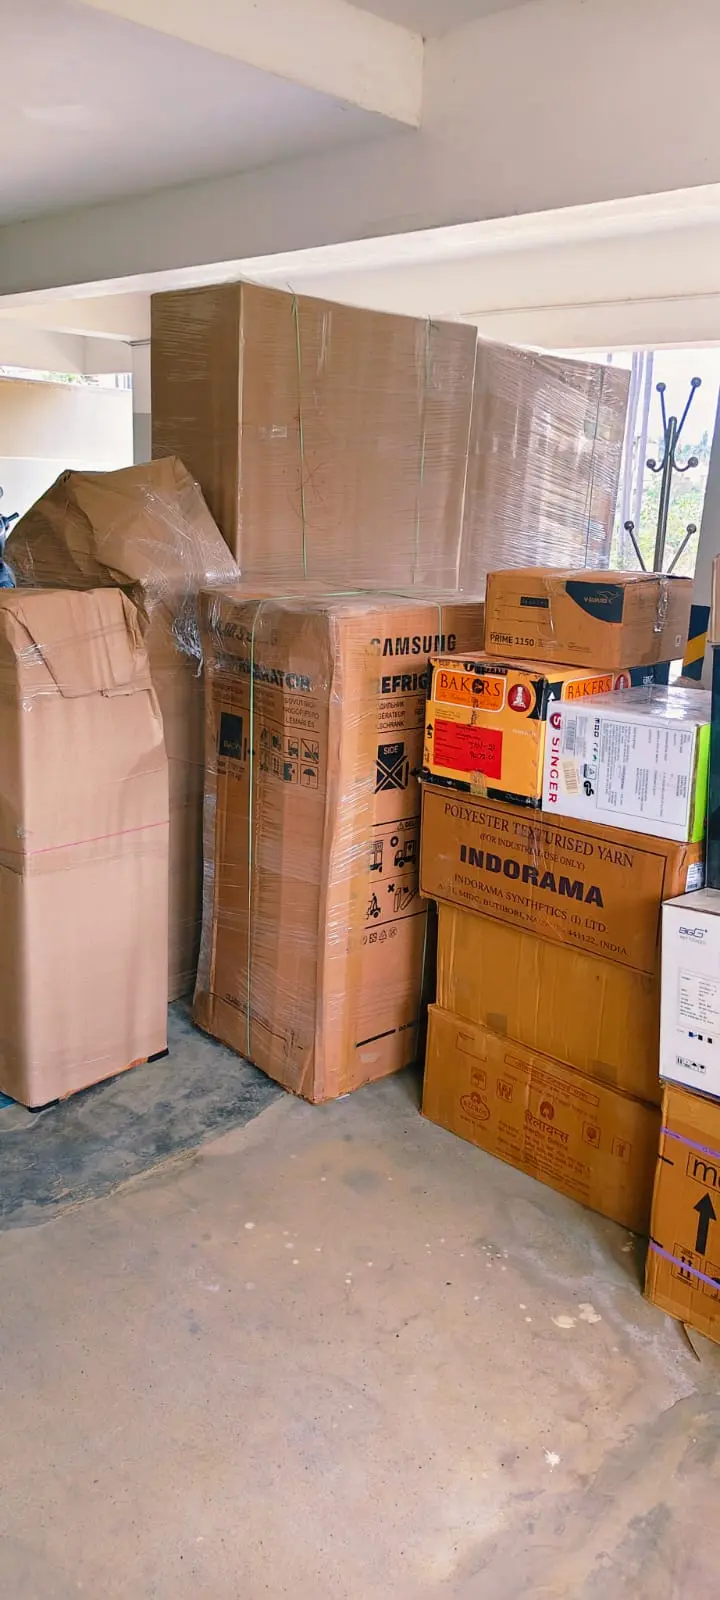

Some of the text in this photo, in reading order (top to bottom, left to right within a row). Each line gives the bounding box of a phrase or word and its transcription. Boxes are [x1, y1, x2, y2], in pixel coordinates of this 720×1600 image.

[490, 633, 513, 644] PRIME
[515, 636, 535, 647] 1150
[440, 673, 501, 697] BAKRS
[567, 678, 611, 699] BAKERS
[383, 745, 399, 755] SIDE
[548, 737, 561, 803] SINGER
[444, 803, 634, 868] POLYESTER TEXTURISED YARN
[479, 833, 497, 844] (FOR
[544, 851, 559, 862] USE
[560, 856, 585, 871] ONLY)
[460, 844, 604, 909] INDORAMA
[454, 873, 504, 898] INDORAMA
[506, 891, 567, 920] SYNTHETICS
